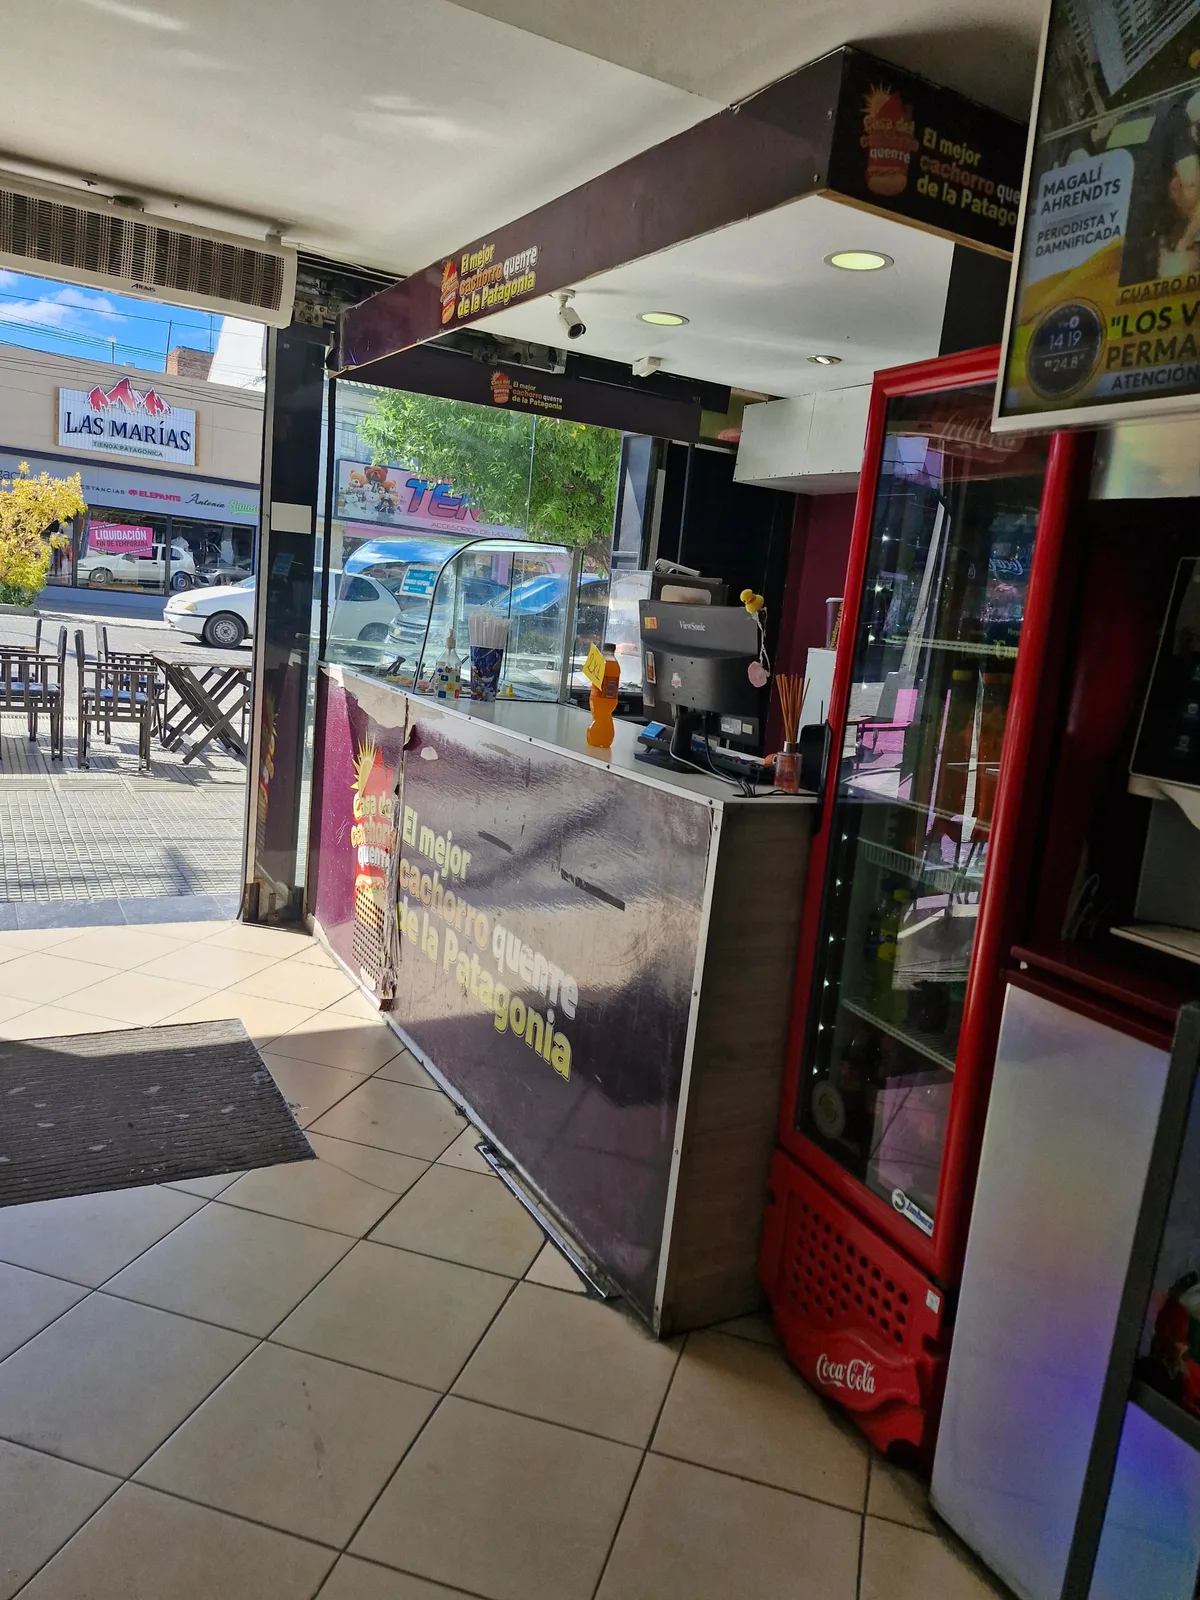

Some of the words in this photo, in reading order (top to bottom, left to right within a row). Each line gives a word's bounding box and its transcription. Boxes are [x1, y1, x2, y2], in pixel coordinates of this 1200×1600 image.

[922, 127, 937, 149] El
[939, 137, 982, 167] mejor
[916, 174, 939, 199] de
[942, 182, 957, 206] la
[919, 154, 995, 194] cachorro
[1043, 163, 1103, 198] MAGALÍ
[1041, 178, 1121, 215] AHRENDTS
[1035, 225, 1121, 257] DAMNIFICADA
[1037, 216, 1105, 243] PERIODISTA
[1110, 210, 1119, 223] Y
[461, 253, 469, 276] El
[470, 244, 495, 270] mejor
[457, 296, 469, 319] de
[471, 291, 480, 313] la
[481, 267, 536, 309] Patagonia
[459, 263, 503, 297] cachorro
[1121, 278, 1182, 303] CUATRO
[512, 389, 543, 400] cachorro
[521, 396, 528, 404] la
[529, 397, 563, 410] Patagonia
[65, 411, 104, 435] LAS
[110, 420, 191, 452] MARÍAS
[92, 440, 118, 450] TIENDA
[185, 493, 226, 508] Antonia
[94, 527, 147, 541] LIQUIDACIÓN
[431, 522, 479, 534] ACCESORIOS
[679, 620, 706, 632] ViewSonic
[353, 790, 376, 819] Casa
[402, 804, 419, 849] El
[419, 824, 472, 884] mejor
[399, 857, 490, 950] cachorro
[397, 895, 419, 946] de
[420, 909, 439, 963] la
[443, 926, 573, 1083] Patagonia
